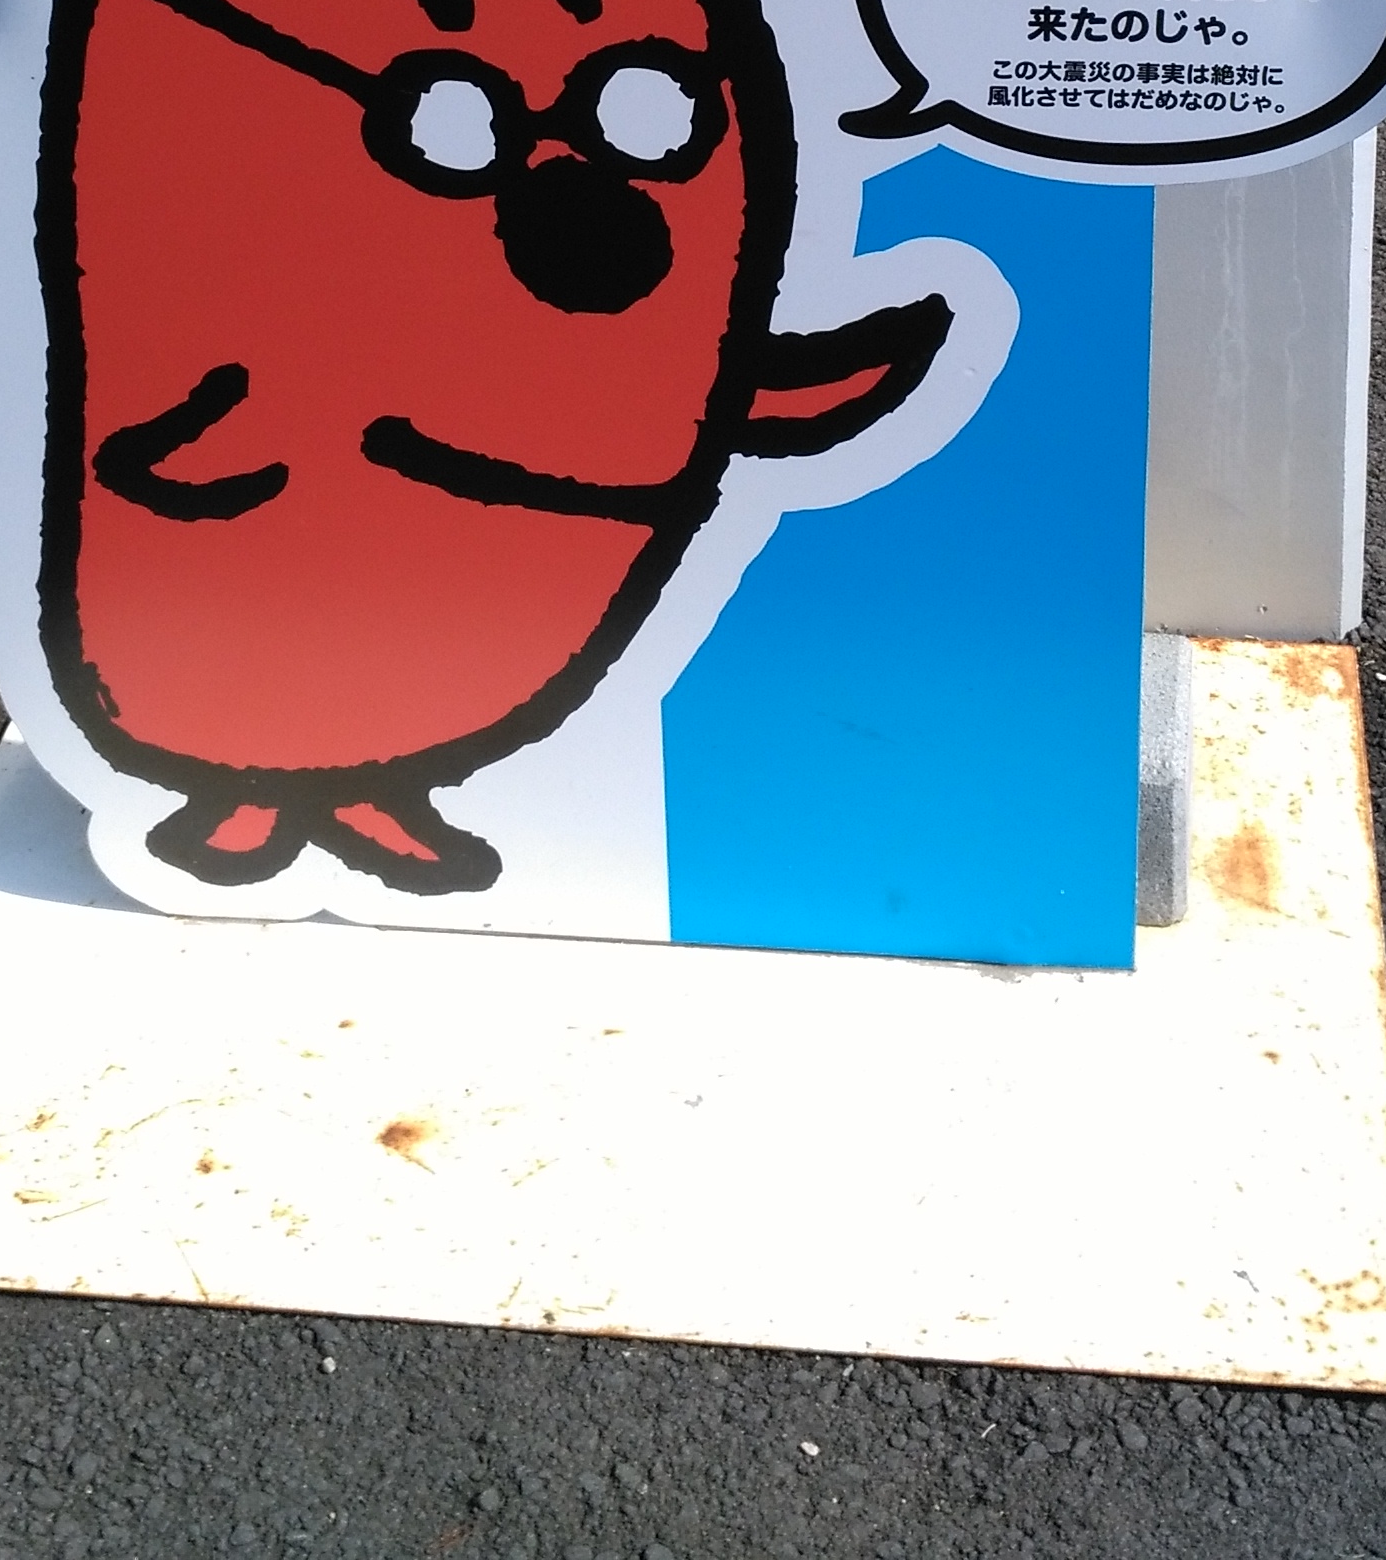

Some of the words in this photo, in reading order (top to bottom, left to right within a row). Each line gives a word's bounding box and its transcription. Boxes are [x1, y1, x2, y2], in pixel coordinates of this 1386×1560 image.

[1026, 4, 1250, 46] 来たのじゃ。
[992, 60, 1285, 87] この大震災の事実は絶対に
[986, 86, 1287, 114] 風化させてはだめなのじゃ。
